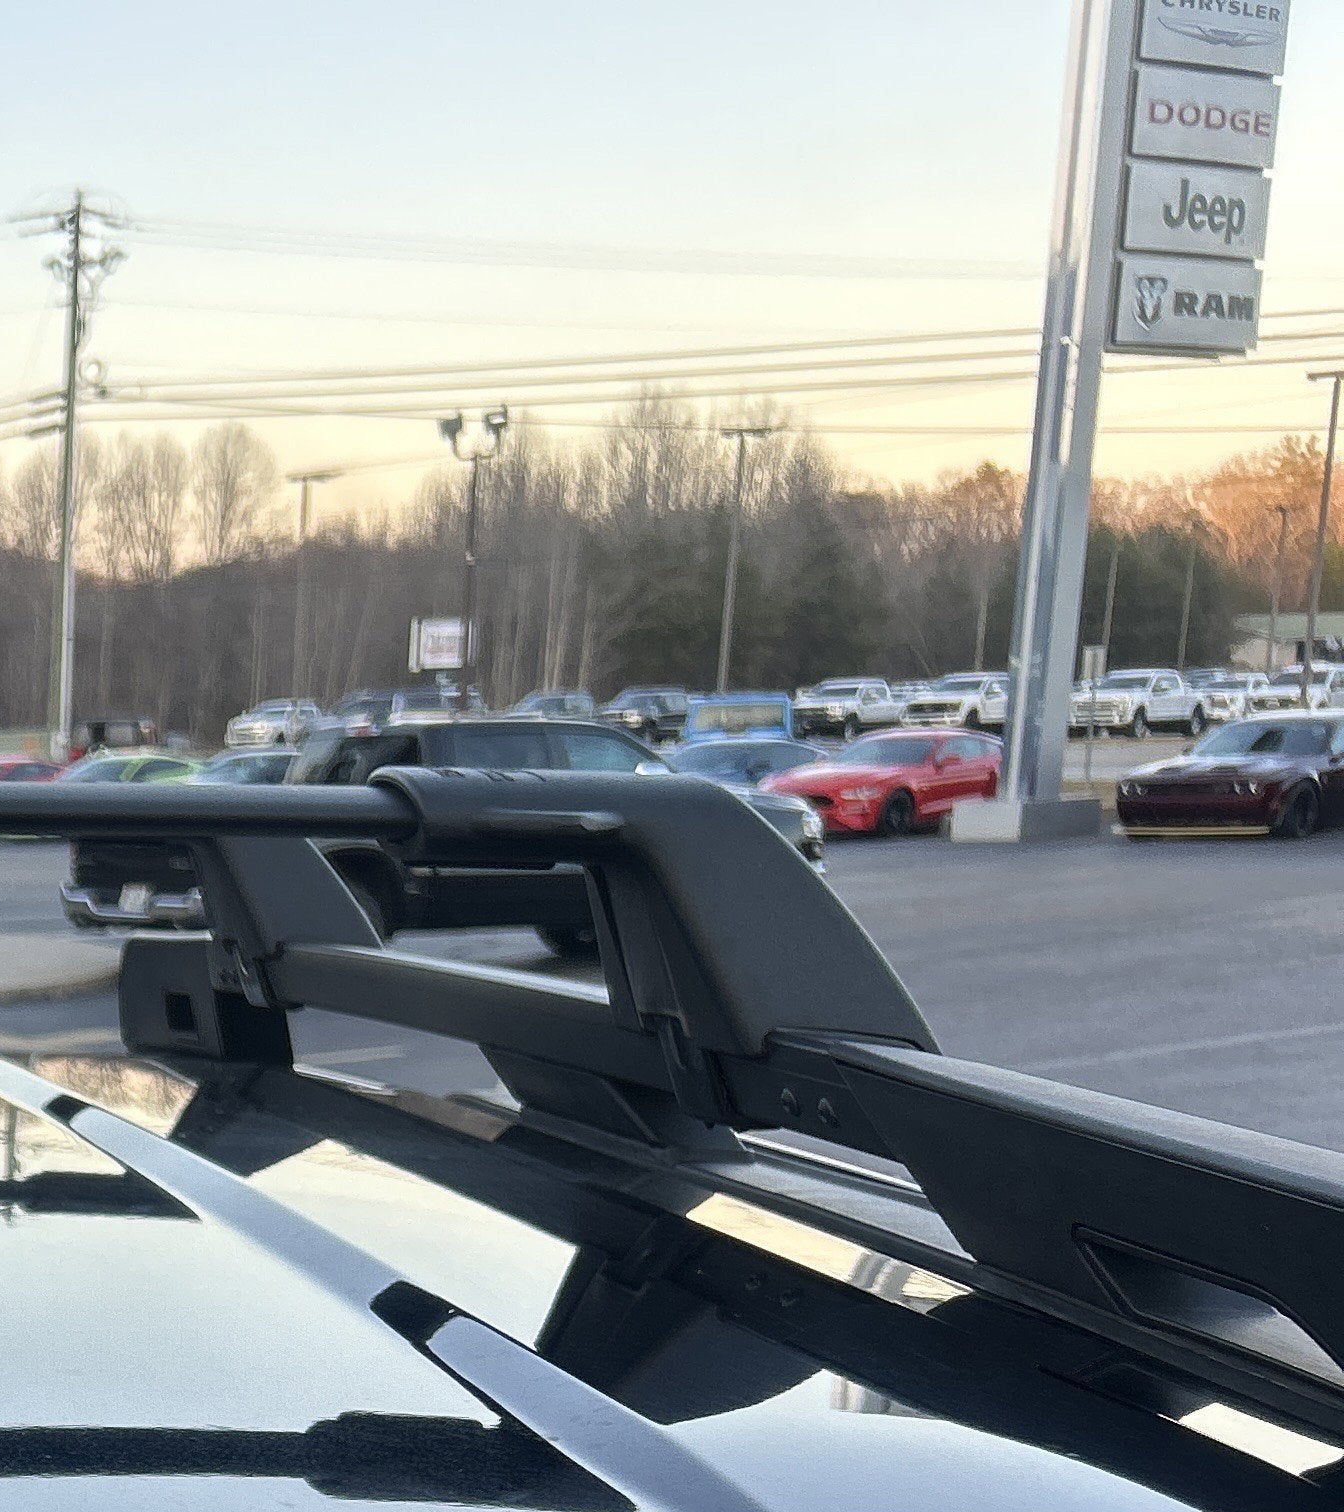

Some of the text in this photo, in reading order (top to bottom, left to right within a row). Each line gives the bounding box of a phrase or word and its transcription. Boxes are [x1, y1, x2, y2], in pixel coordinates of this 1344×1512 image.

[1148, 99, 1271, 137] DODGE
[1163, 177, 1246, 244] Jeep
[1173, 291, 1254, 321] RAM
